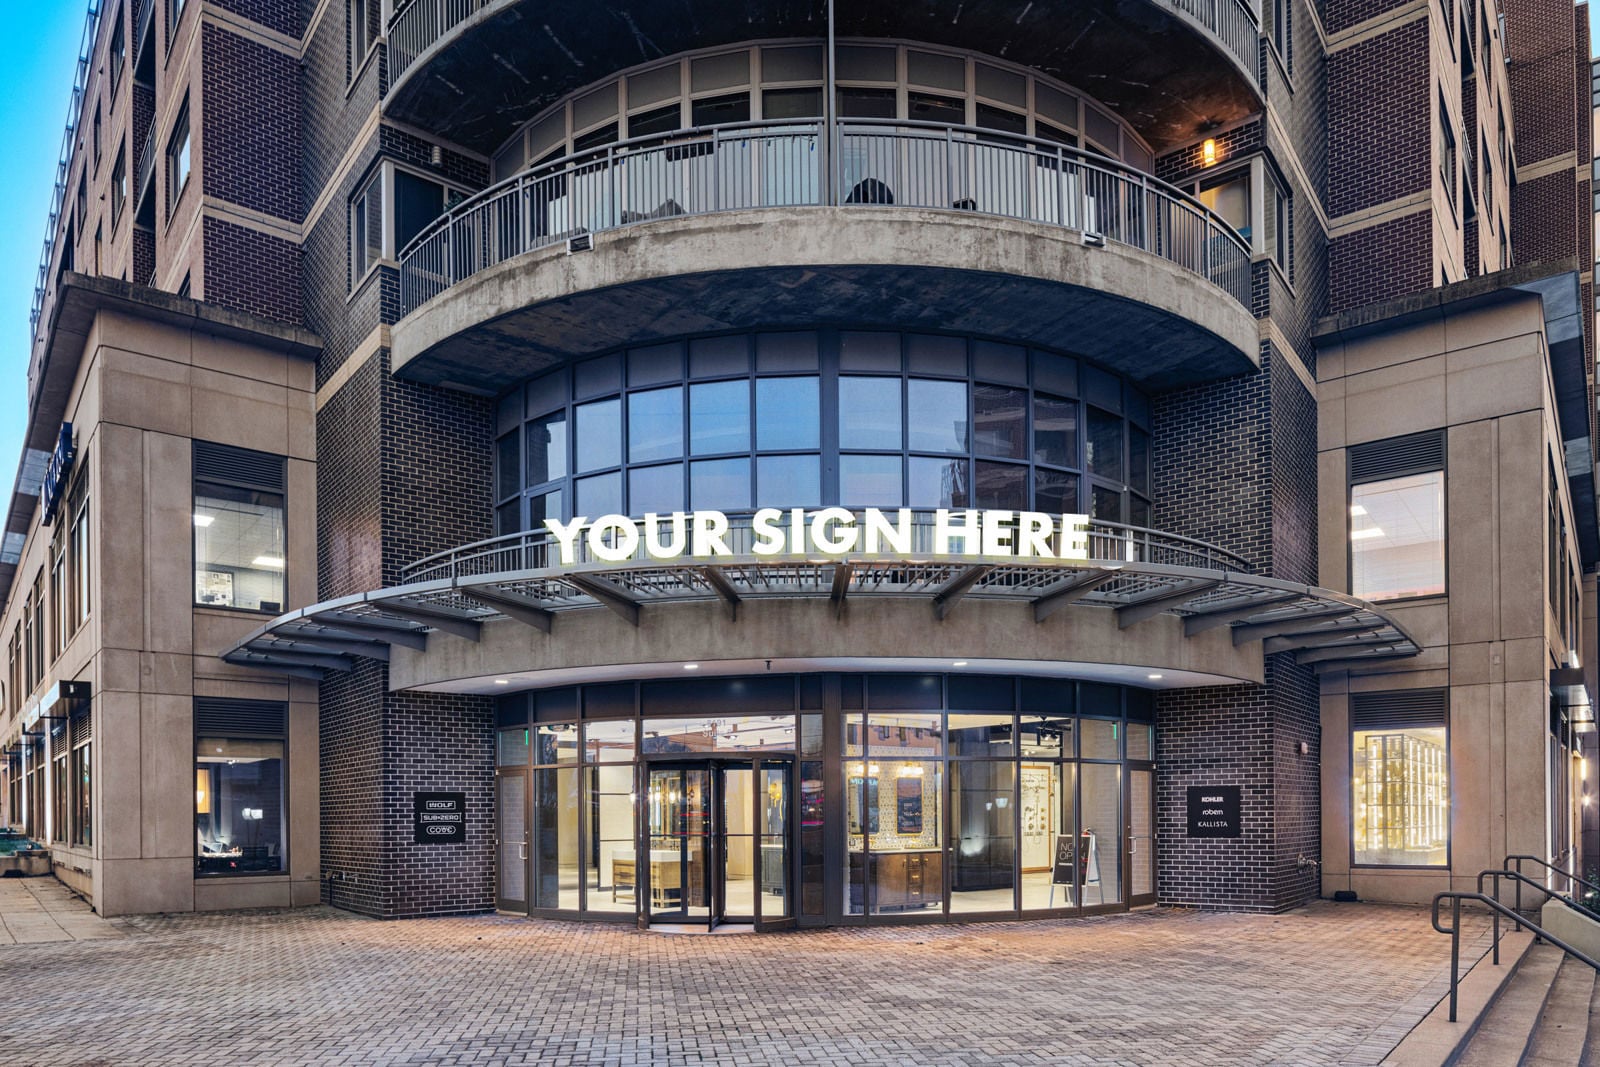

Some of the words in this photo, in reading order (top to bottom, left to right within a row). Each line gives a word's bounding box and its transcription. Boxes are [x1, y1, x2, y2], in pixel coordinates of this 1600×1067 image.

[543, 510, 733, 565] YOUR
[752, 507, 911, 555] SIGN
[935, 508, 1089, 559] HERE
[1060, 842, 1084, 851] NO
[1059, 851, 1086, 860] OPN
